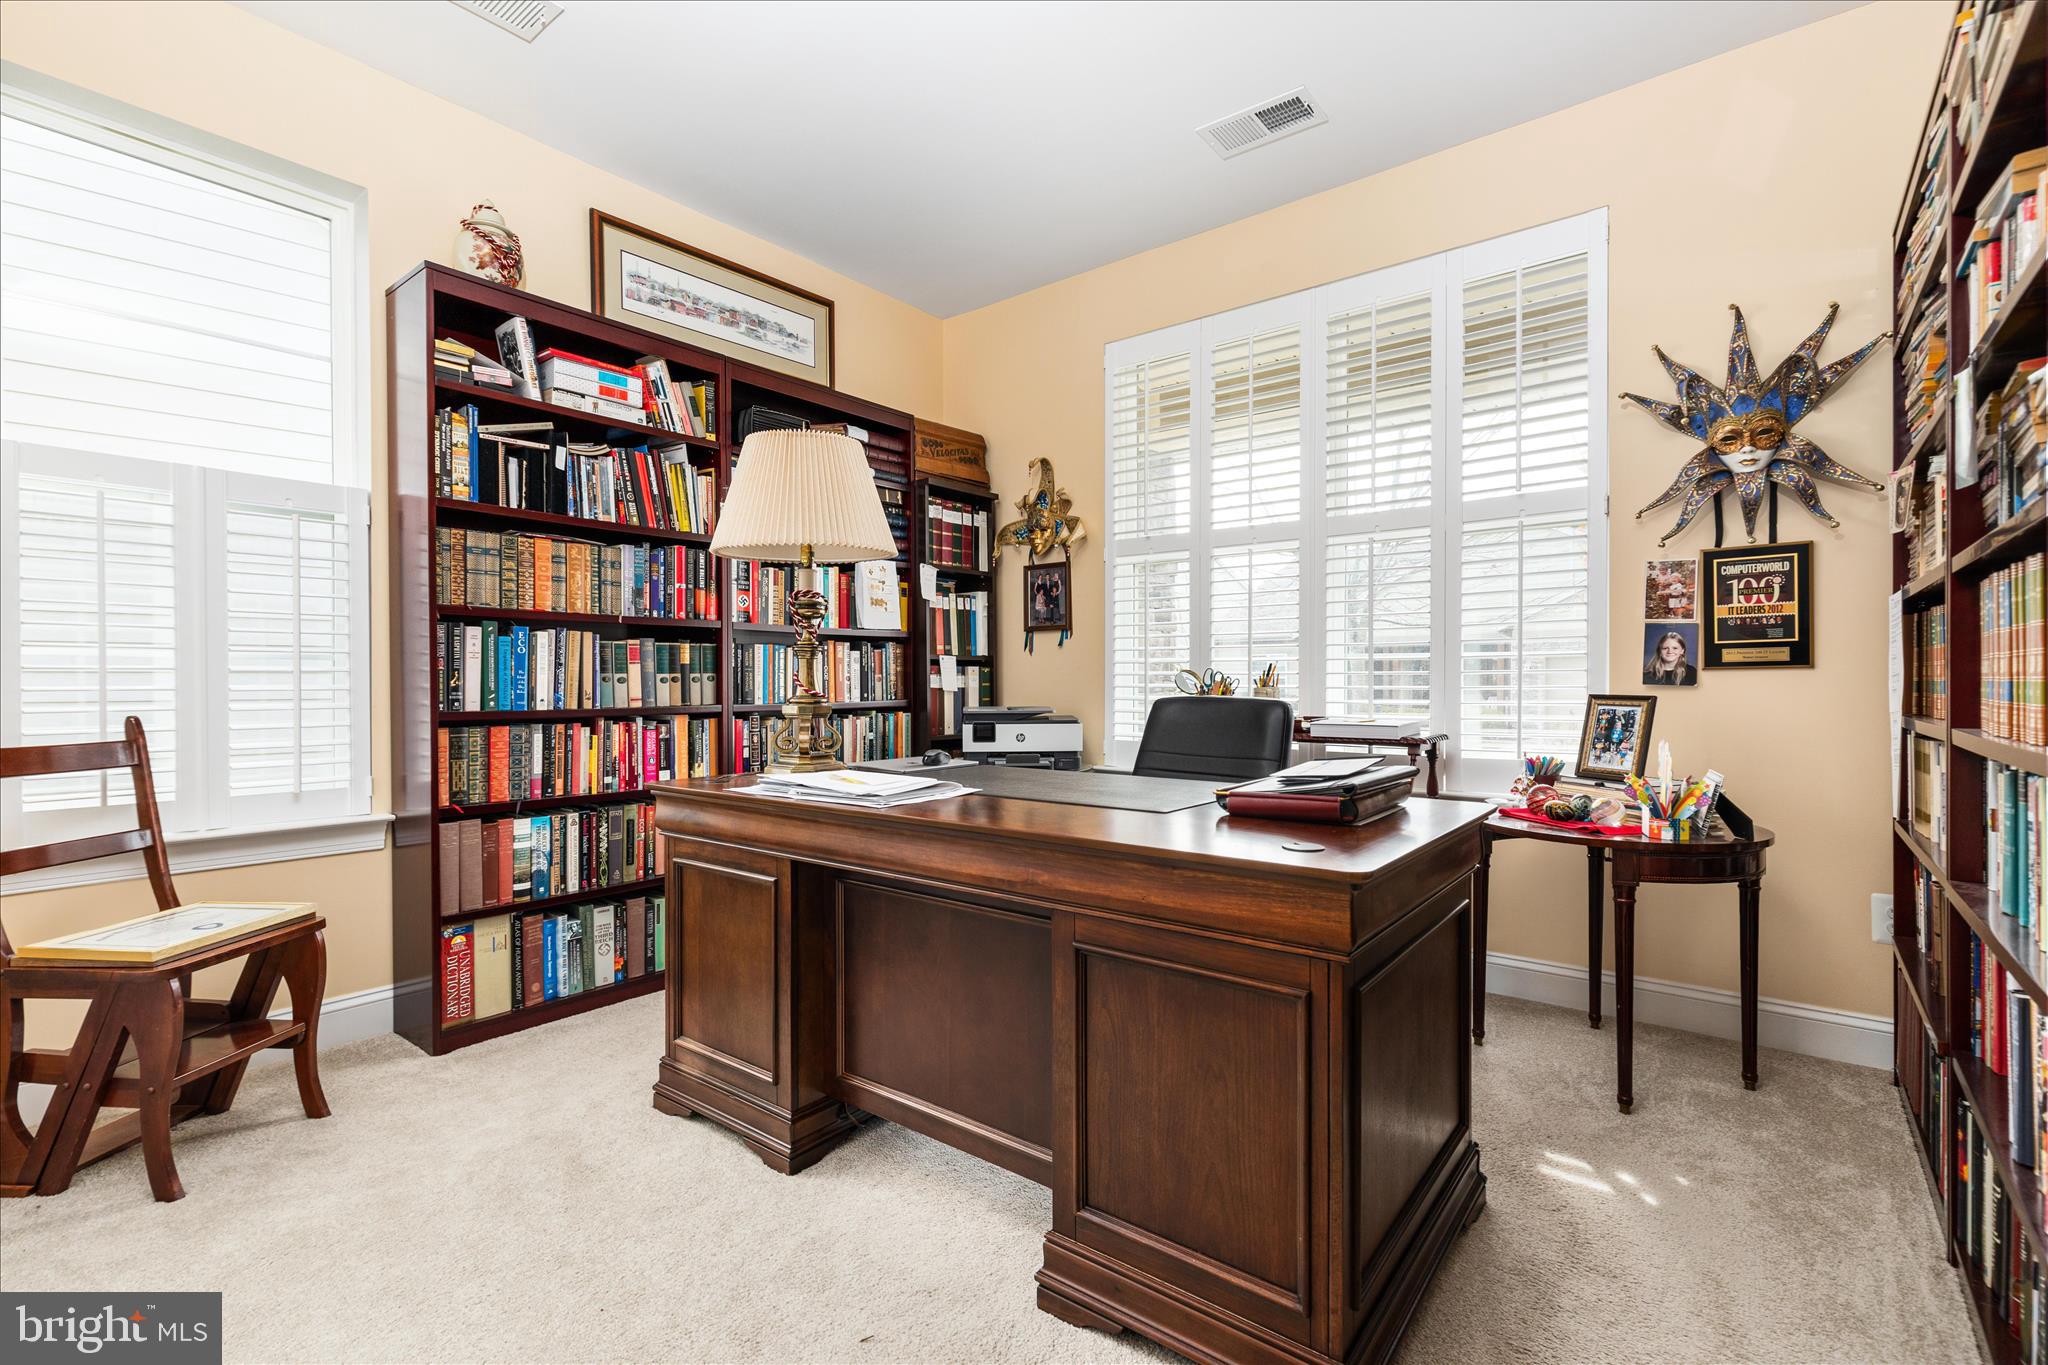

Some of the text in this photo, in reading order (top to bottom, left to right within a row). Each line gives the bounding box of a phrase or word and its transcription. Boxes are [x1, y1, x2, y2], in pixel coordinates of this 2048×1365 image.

[1720, 562, 1790, 576] COMPUTERWORLD
[1728, 604, 1784, 615] IT LEADERS 2012
[514, 920, 522, 937] ATLAS
[515, 938, 522, 947] OF
[446, 955, 459, 1018] DICTIONARY
[459, 950, 471, 1017] UNABRIDGED
